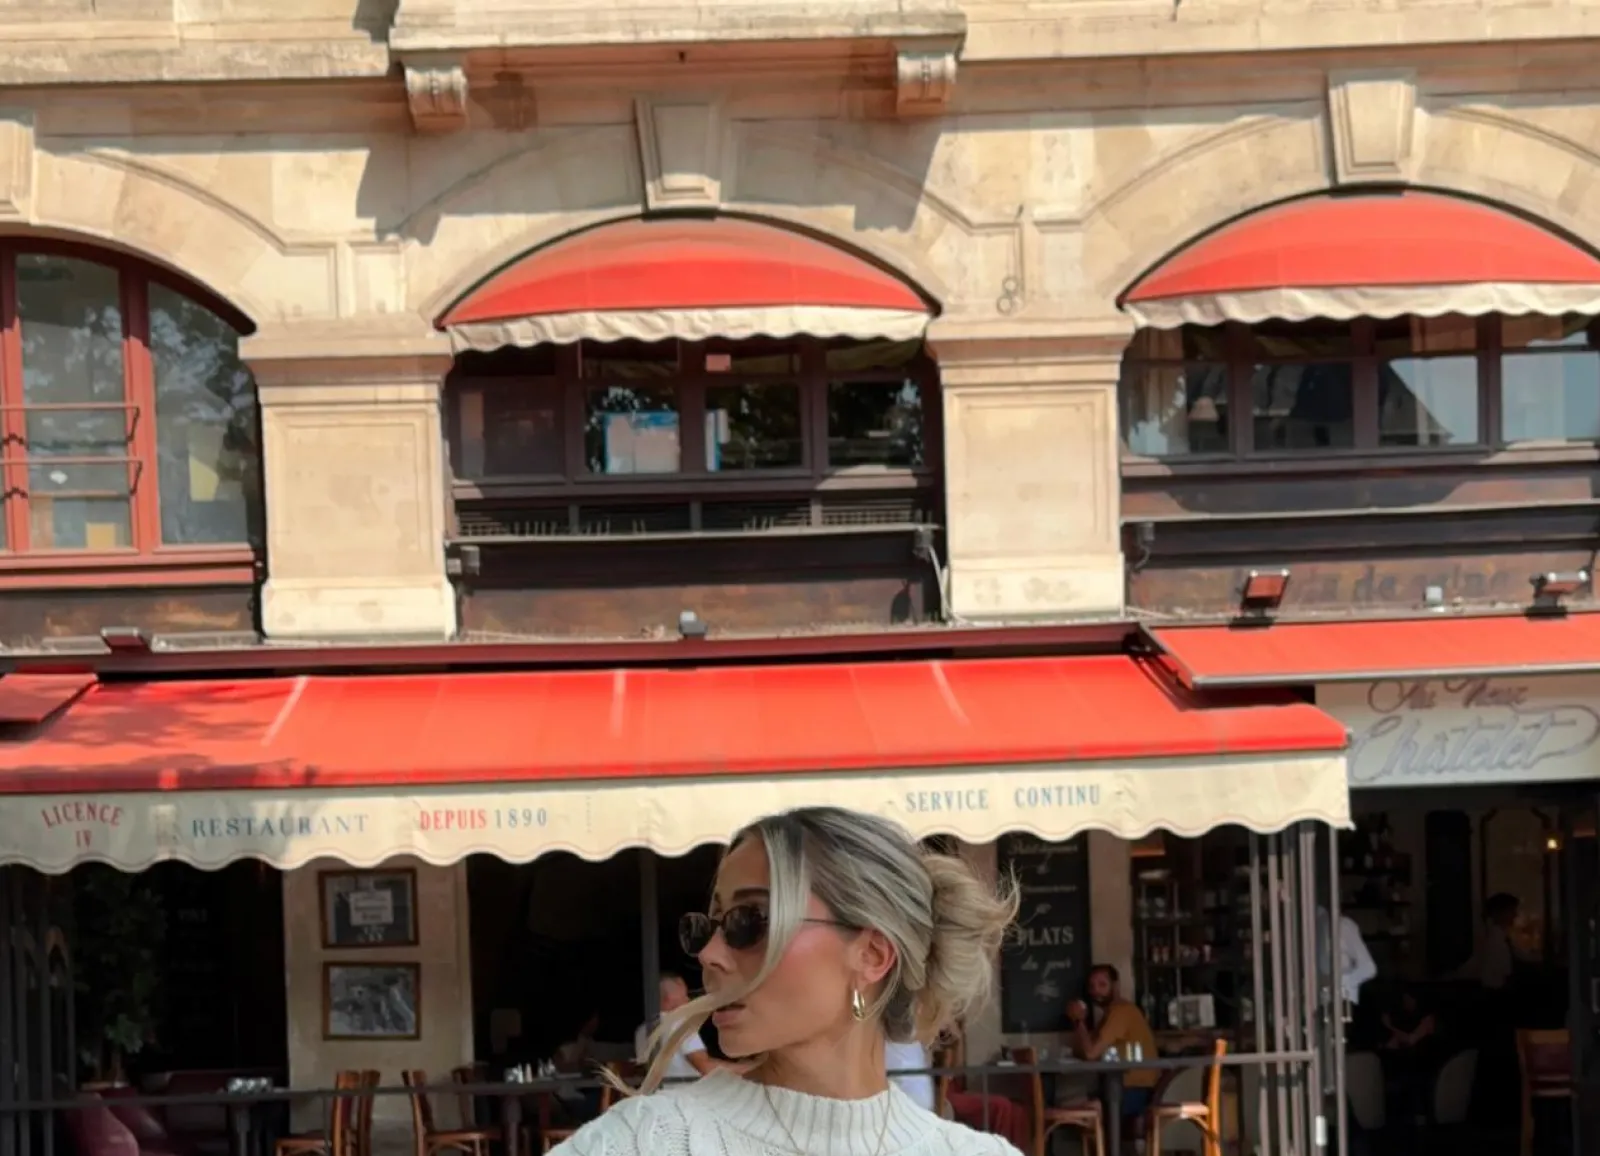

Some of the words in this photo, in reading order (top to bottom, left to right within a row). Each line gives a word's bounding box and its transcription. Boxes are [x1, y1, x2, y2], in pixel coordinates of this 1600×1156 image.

[906, 788, 989, 812] SERVICE
[1014, 783, 1101, 809] CONTINU
[41, 800, 125, 828] LICENCE
[420, 808, 487, 830] DEPUIS
[495, 807, 547, 828] 1890
[192, 814, 370, 838] RESTAURANT
[75, 829, 92, 848] IV
[1016, 926, 1075, 946] PLATS
